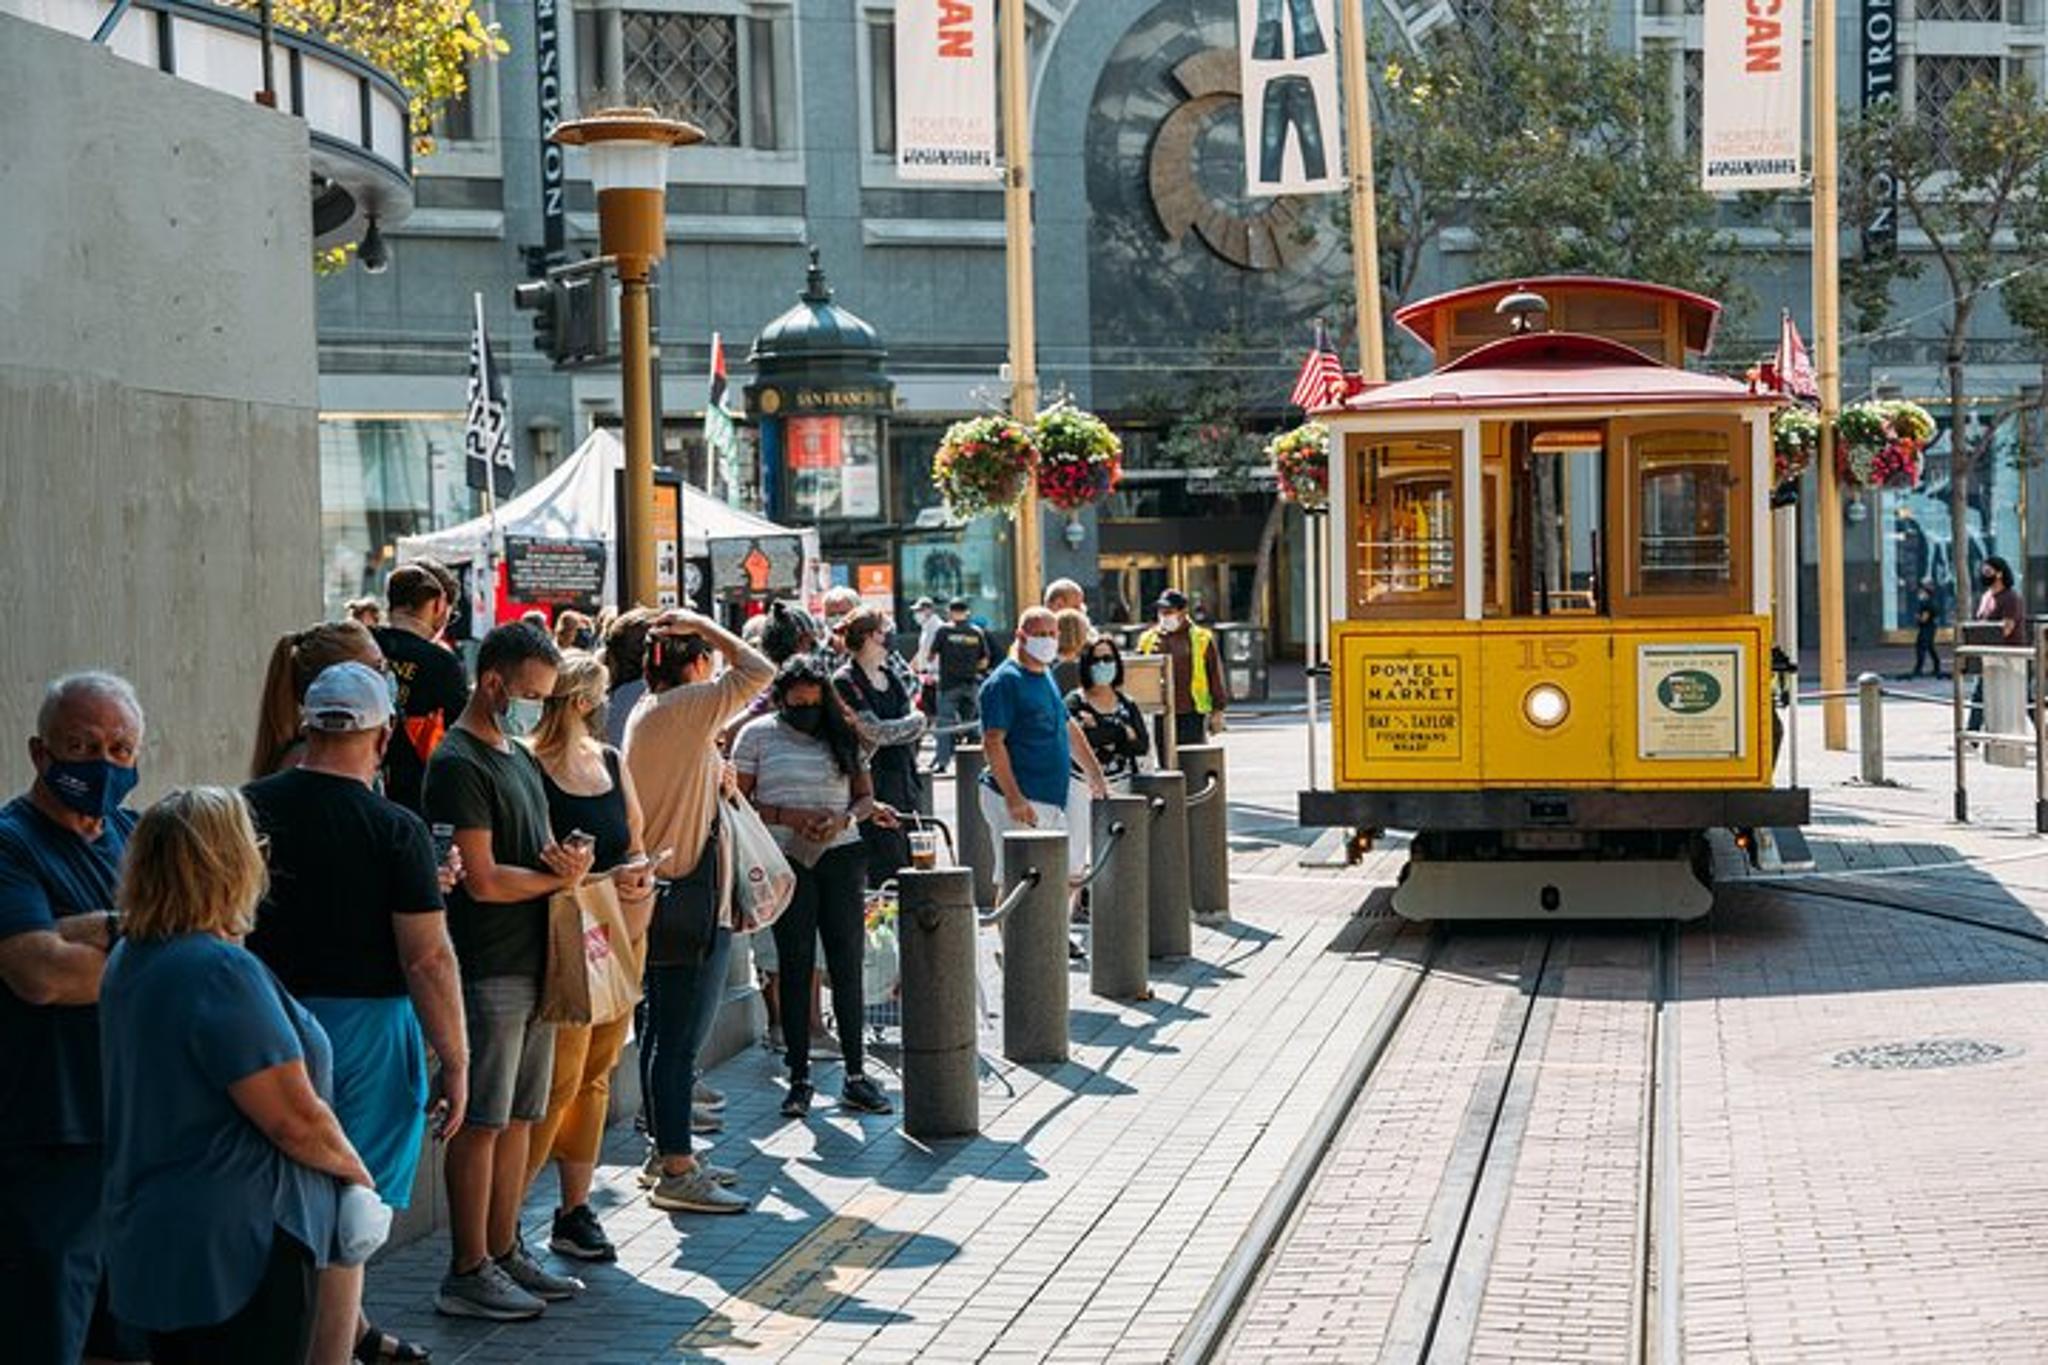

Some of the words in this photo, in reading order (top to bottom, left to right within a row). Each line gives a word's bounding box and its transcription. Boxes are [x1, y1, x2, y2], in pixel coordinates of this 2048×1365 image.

[1516, 639, 1579, 670] 15
[1370, 663, 1454, 677] POWELL
[1393, 677, 1434, 688] AND
[1368, 688, 1456, 700] MARKET
